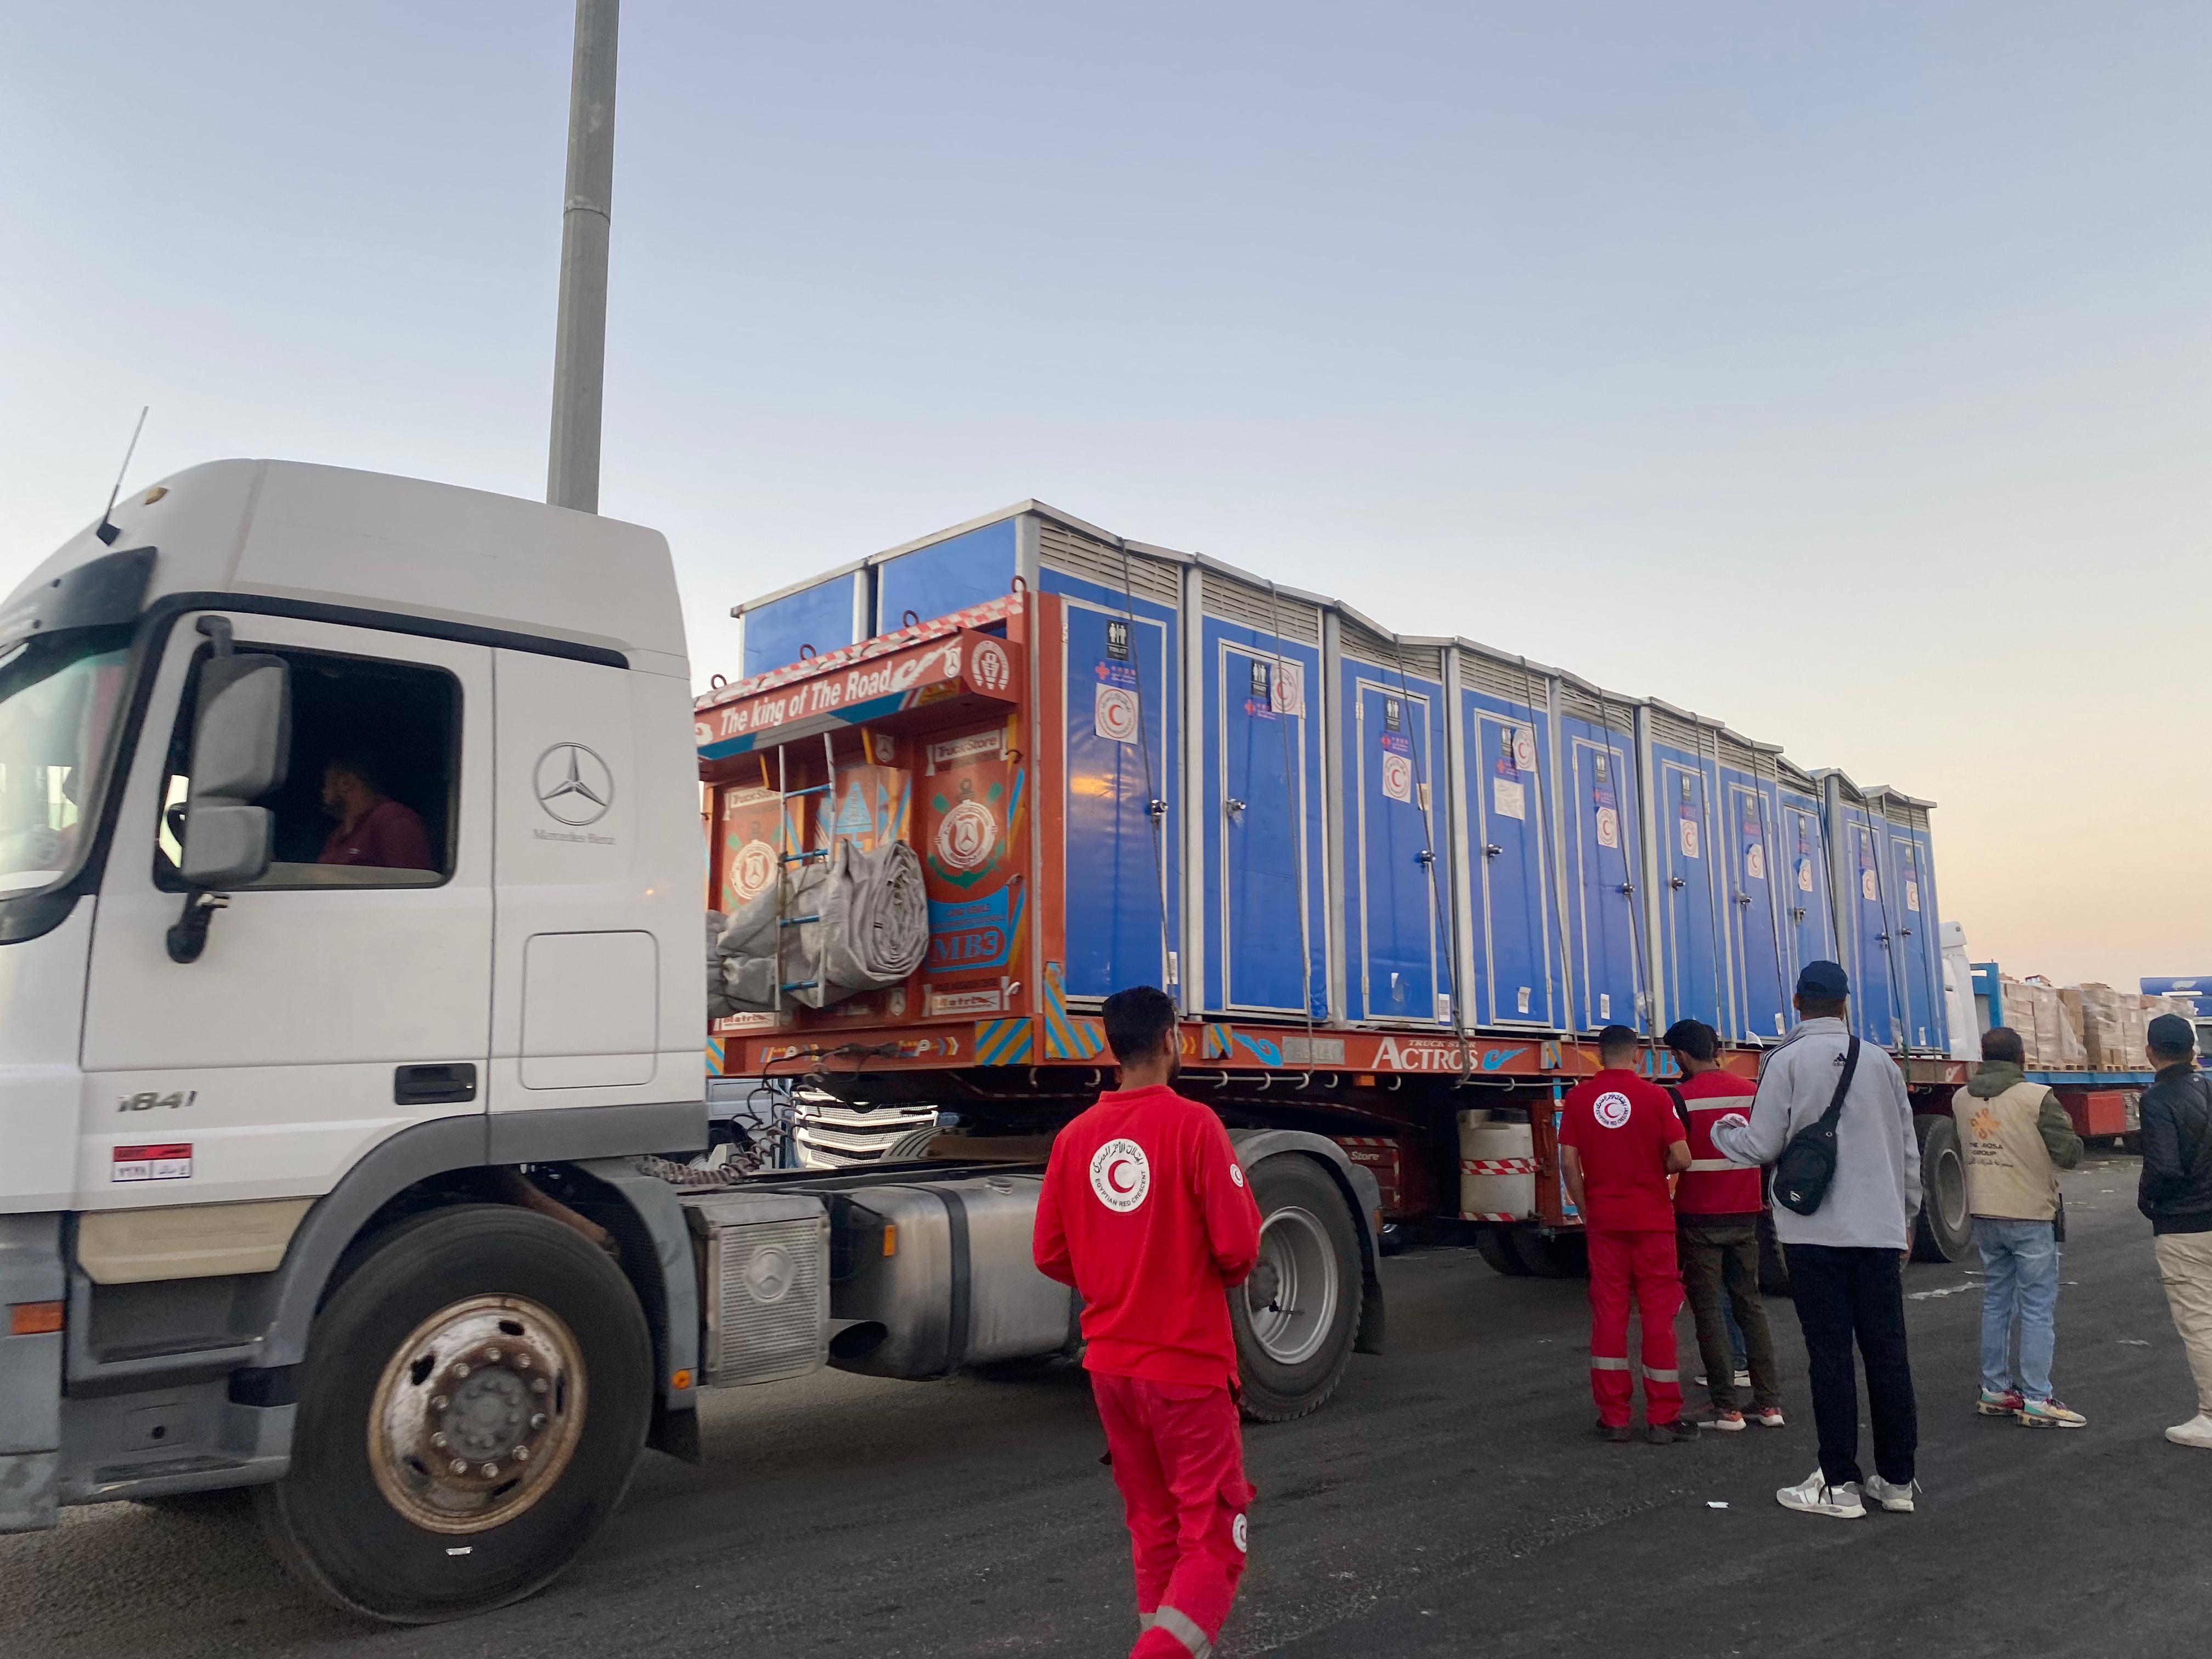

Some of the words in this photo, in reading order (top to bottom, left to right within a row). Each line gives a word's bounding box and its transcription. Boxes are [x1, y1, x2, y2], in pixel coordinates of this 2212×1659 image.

[720, 707, 748, 736] The
[789, 685, 809, 717] of
[811, 679, 841, 711] The
[844, 660, 893, 702] Road
[1408, 1039, 1445, 1047] TRUCK
[1350, 1151, 1380, 1161] Store
[1095, 1178, 1118, 1206] EGYPTIAN
[1131, 1170, 1146, 1203] CRESCENT
